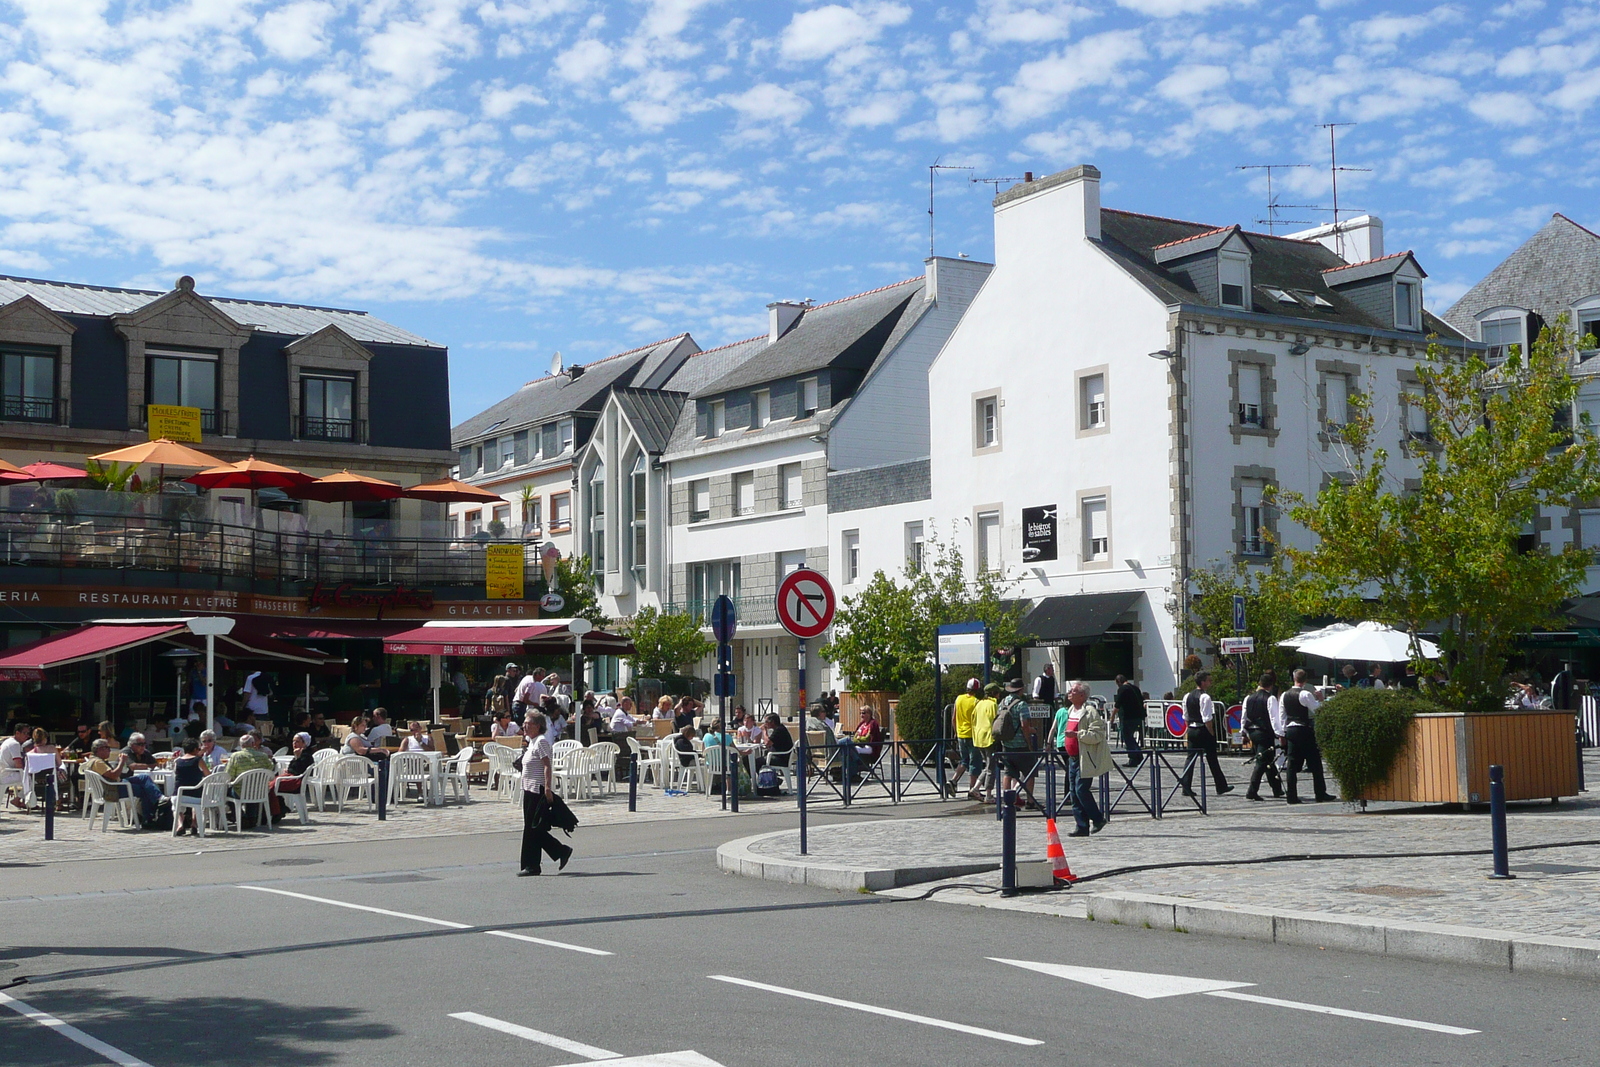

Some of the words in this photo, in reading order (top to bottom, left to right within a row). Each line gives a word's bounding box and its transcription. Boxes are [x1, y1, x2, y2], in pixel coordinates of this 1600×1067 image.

[1034, 529, 1051, 537] sables
[0, 591, 40, 602] ERIA
[79, 592, 178, 605] RESTAURANT
[183, 598, 190, 606] A
[196, 596, 238, 608] L'ETAGE
[254, 600, 298, 612] BRASSERIE
[448, 605, 524, 615] GLACIER
[1236, 603, 1242, 624] P
[443, 645, 454, 654] BAR
[458, 645, 478, 655] LOUNGE
[483, 645, 516, 655] RESTAURANT
